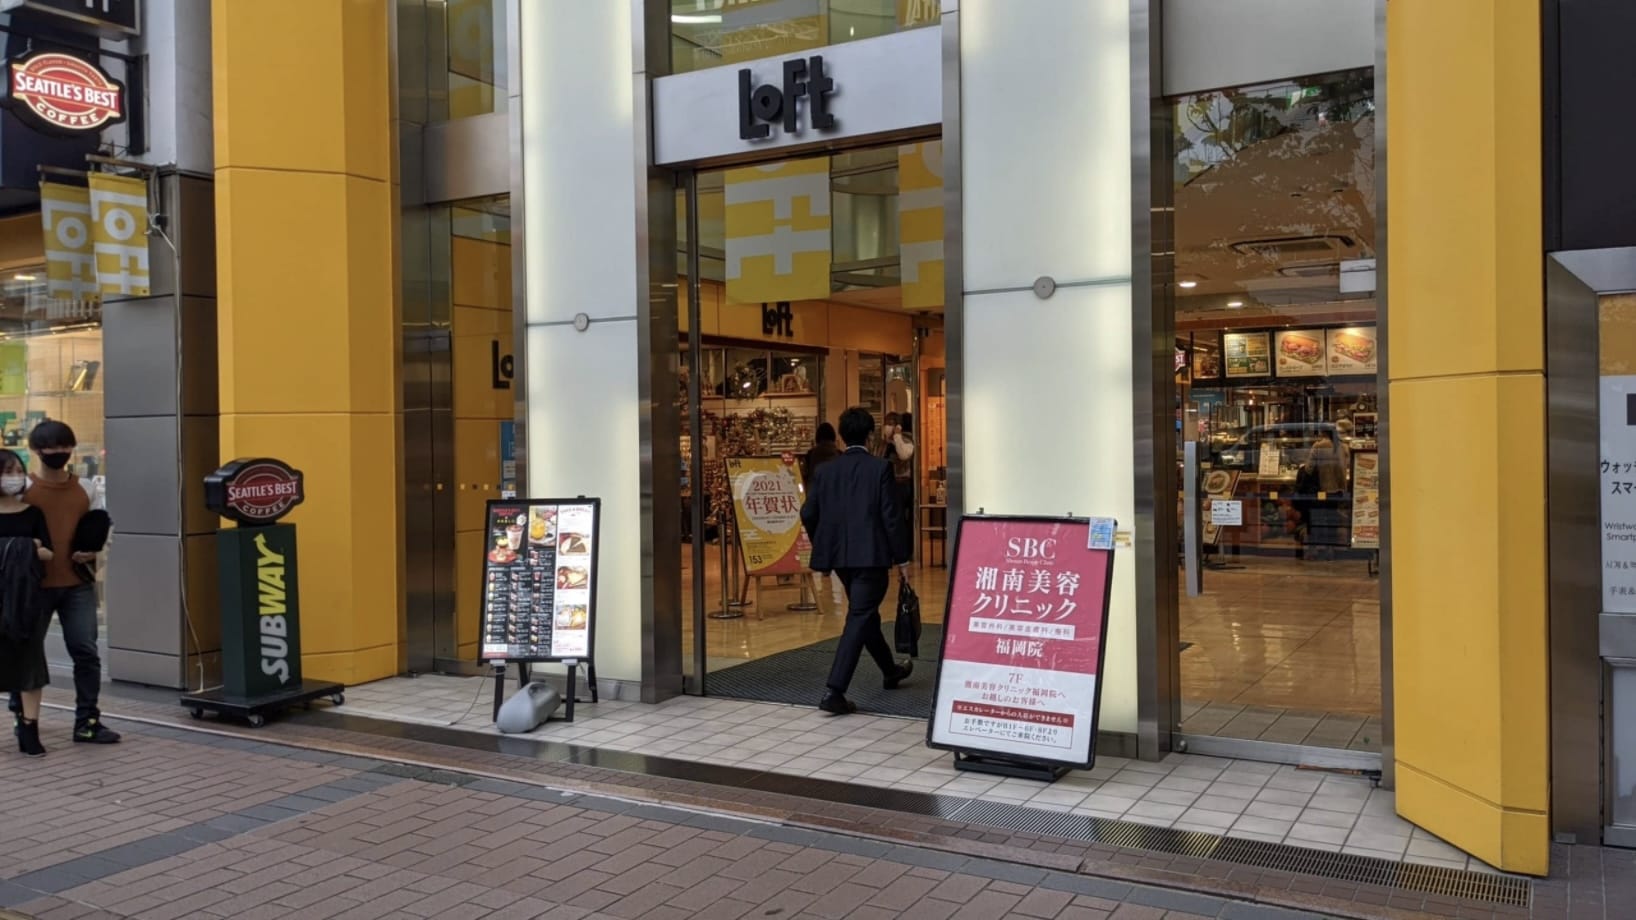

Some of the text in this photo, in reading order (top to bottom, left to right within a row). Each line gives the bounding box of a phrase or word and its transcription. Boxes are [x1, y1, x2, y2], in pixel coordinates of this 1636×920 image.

[15, 72, 118, 109] SEATTLE'S BEST
[36, 102, 100, 126] COFFEE
[228, 481, 297, 501] SEATTLE'S BEST
[753, 480, 782, 492] 2021
[242, 502, 286, 515] COFFEE
[745, 495, 799, 515] 年賀状
[1006, 537, 1057, 560] SBC
[975, 566, 1081, 597] 湘南美容
[254, 533, 291, 685] SUBWAY
[970, 592, 1078, 622] クリニック
[996, 638, 1045, 658] 福岡院
[1008, 672, 1025, 684] 7F
